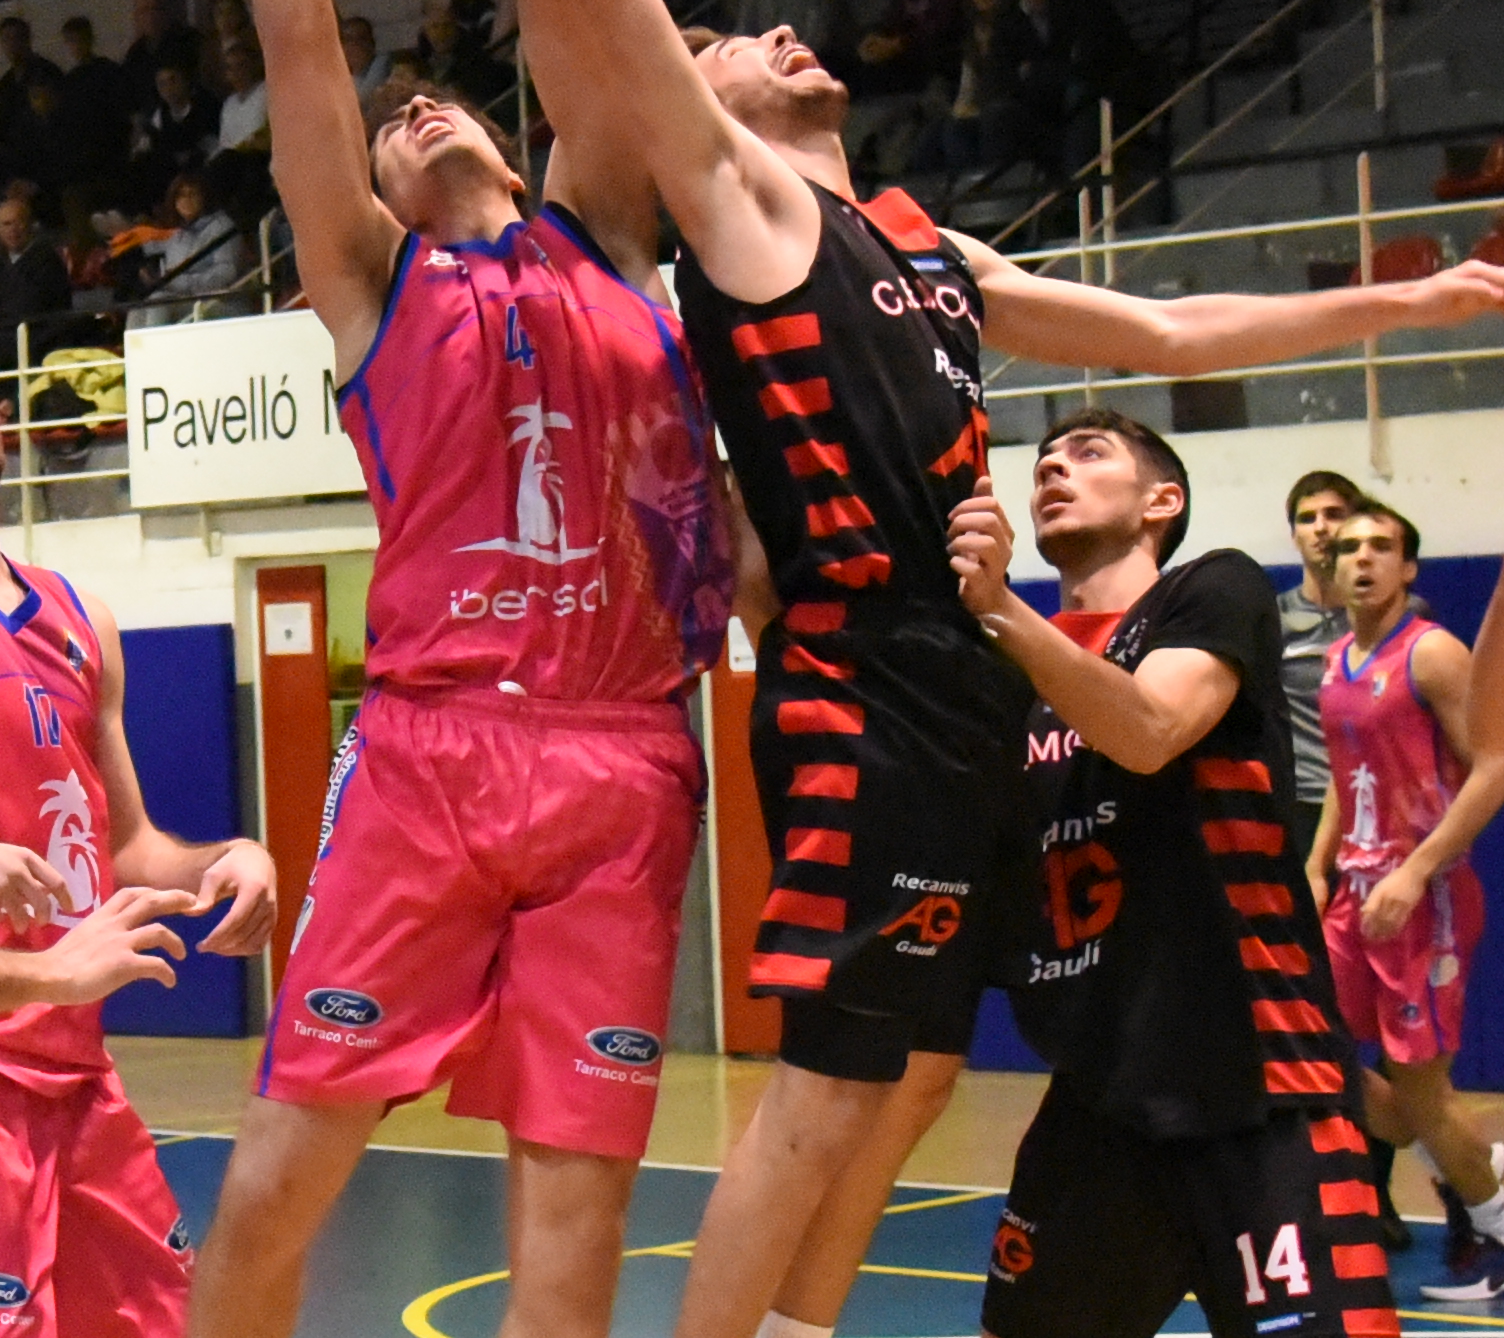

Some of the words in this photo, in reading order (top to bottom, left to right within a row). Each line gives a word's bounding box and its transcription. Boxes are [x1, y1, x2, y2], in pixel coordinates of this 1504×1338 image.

[506, 303, 535, 370] 4
[141, 374, 298, 452] Pavelló
[892, 873, 971, 897] Recanvis
[320, 993, 370, 1023] Ford
[293, 1020, 341, 1044] Tarraco
[606, 1031, 650, 1060] Ford
[574, 1059, 627, 1082] Tarraco
[1236, 1222, 1312, 1305] 14
